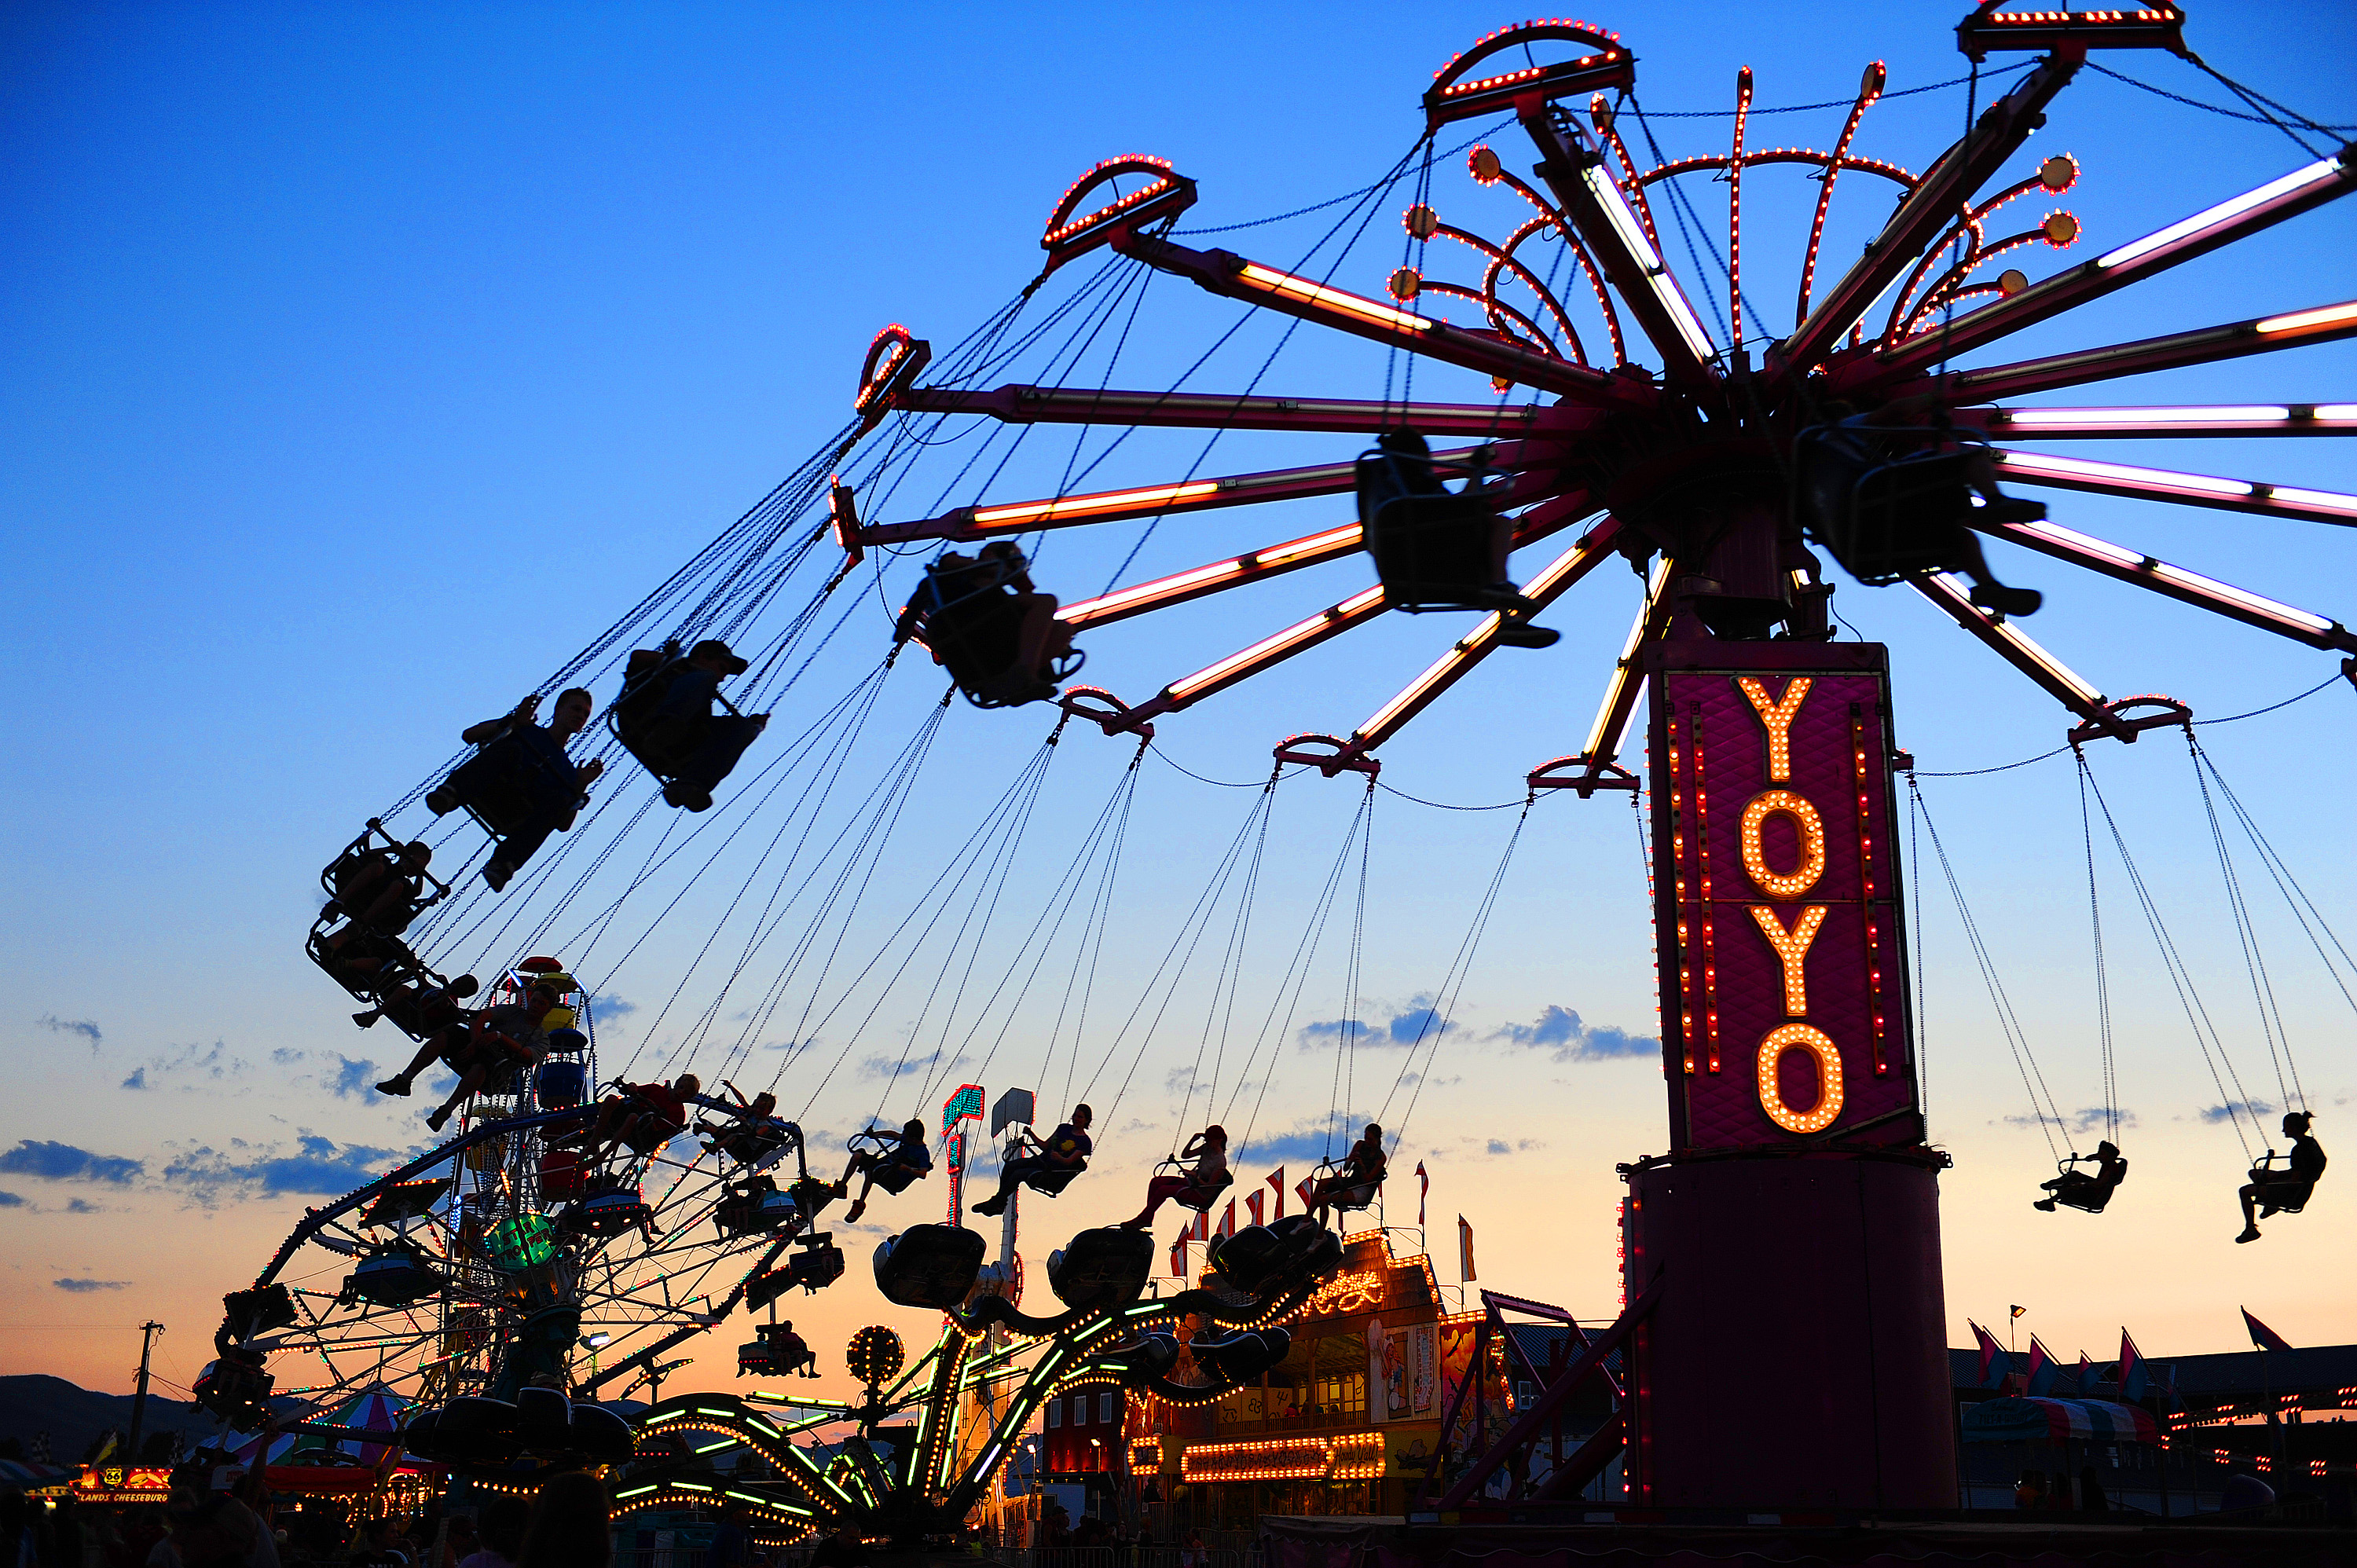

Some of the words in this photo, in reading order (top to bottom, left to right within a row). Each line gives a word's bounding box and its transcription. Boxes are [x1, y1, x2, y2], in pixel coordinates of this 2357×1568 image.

[1731, 676, 1845, 1134] YOYO
[497, 1228, 550, 1264] TROPER
[503, 1221, 535, 1246] STR
[1333, 1443, 1357, 1467] Howdy
[79, 1493, 111, 1502] LANDS
[114, 1493, 168, 1502] CHEESEBURG
